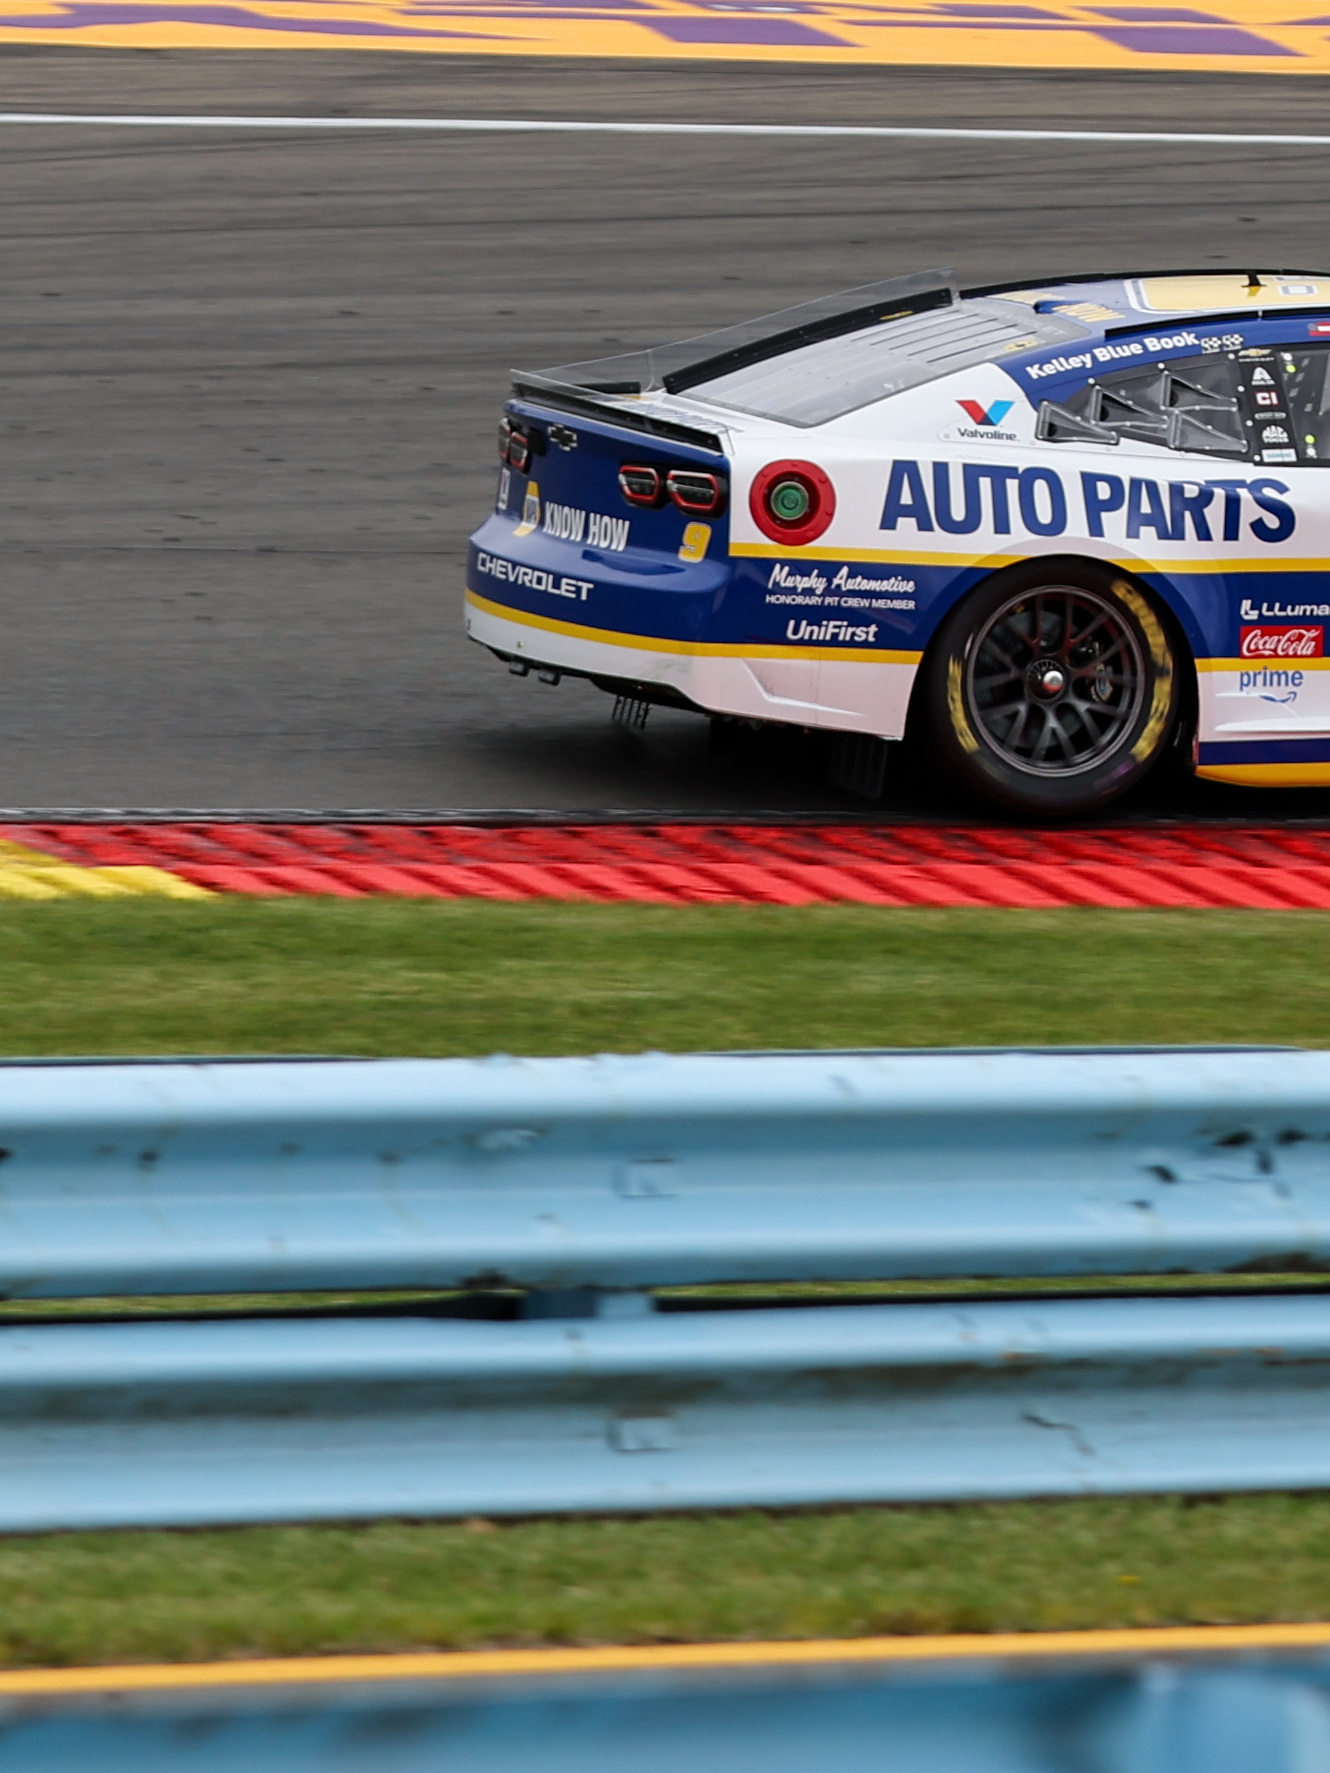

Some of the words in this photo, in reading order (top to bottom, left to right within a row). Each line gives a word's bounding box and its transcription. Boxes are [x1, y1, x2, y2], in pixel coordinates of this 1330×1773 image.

[1025, 354, 1093, 379] Kelley
[1092, 342, 1144, 364] Blue
[1144, 331, 1200, 354] Book
[957, 428, 1017, 440] Valvoline
[878, 459, 1068, 538] AUTO
[1080, 471, 1297, 543] PARTS
[543, 501, 585, 542] KNOW
[586, 512, 630, 551] HOW
[679, 521, 712, 562] 9
[477, 552, 594, 601] CHEVROLET
[768, 563, 828, 594] Murphy
[831, 565, 916, 593] Automotive
[766, 594, 823, 605] HONORARY
[824, 597, 839, 606] PIT
[840, 598, 871, 608] CREW
[871, 599, 916, 610] MEMBER
[786, 619, 879, 642] UniFirst
[1242, 629, 1320, 656] Coca-Cola
[1240, 665, 1304, 691] prime
